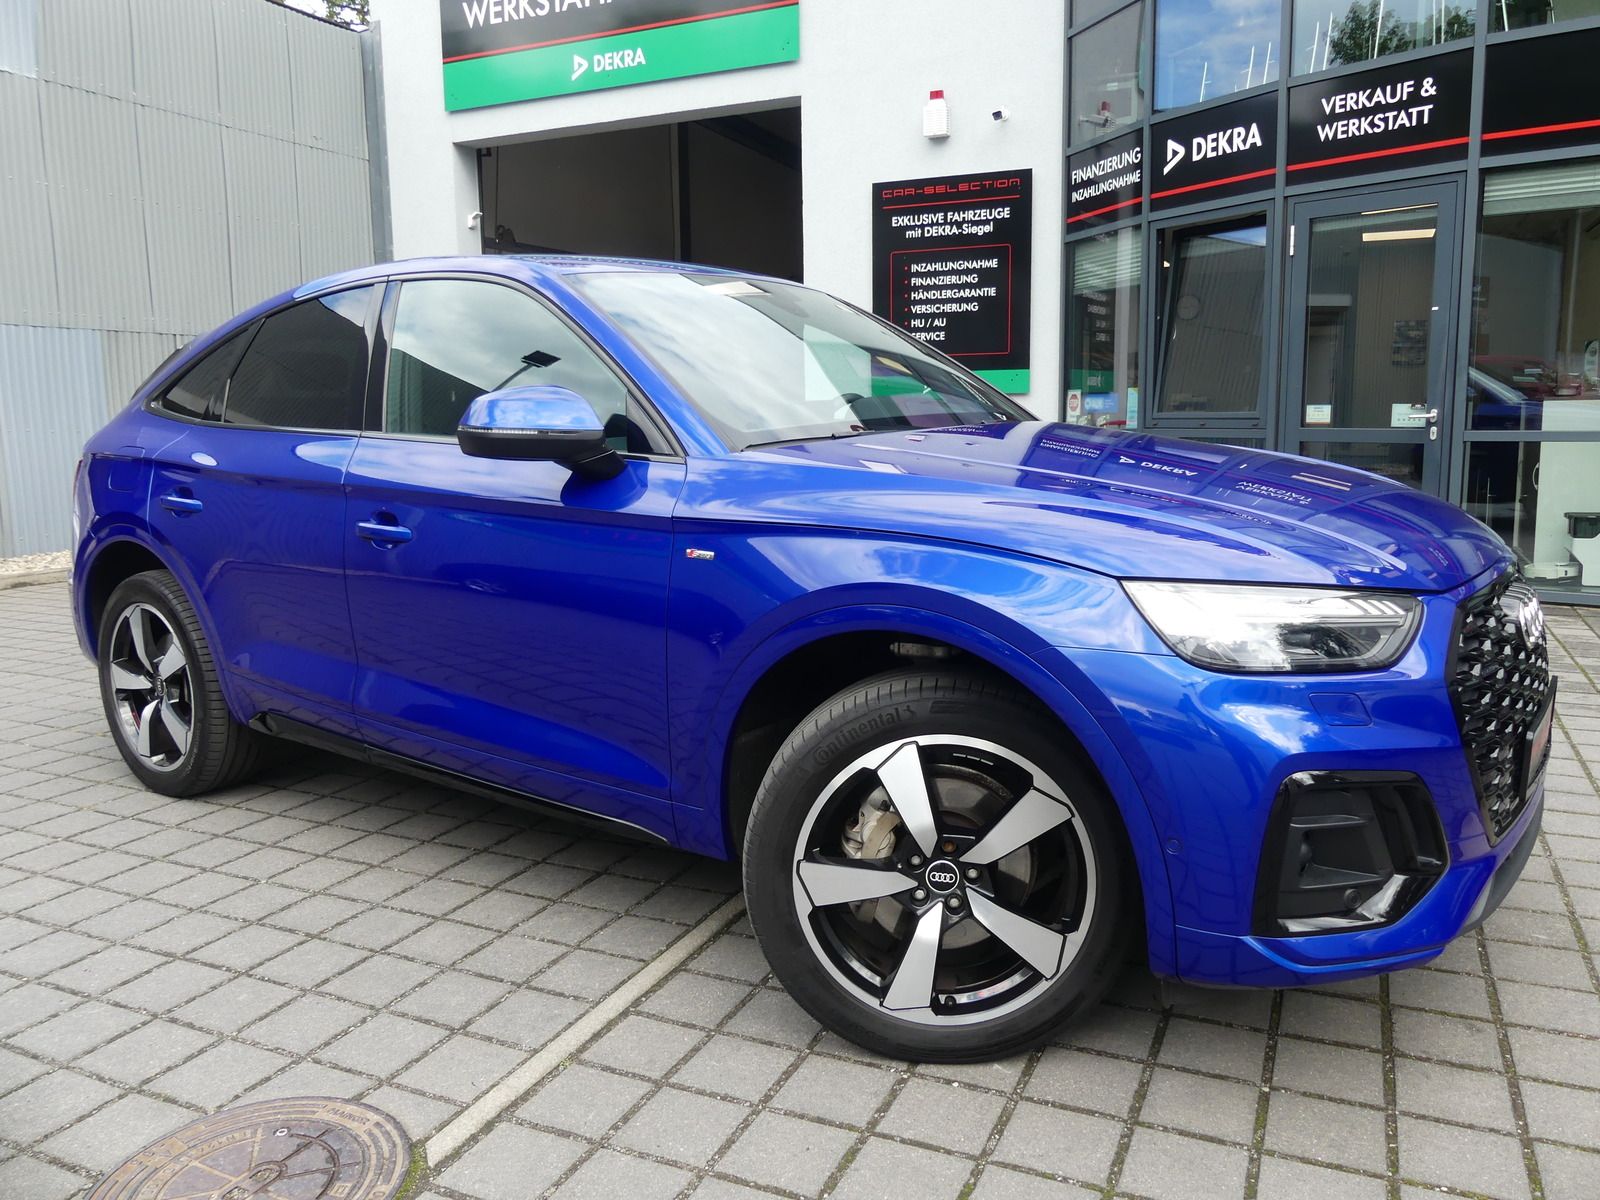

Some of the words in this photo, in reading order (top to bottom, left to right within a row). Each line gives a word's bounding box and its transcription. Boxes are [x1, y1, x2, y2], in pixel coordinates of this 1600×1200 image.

[462, 0, 606, 29] WERKS
[593, 47, 646, 72] DEKRA
[1321, 80, 1415, 116] VERKAUF
[1420, 77, 1437, 97] &
[1316, 104, 1434, 143] WERKSTATT
[1192, 122, 1262, 162] DEKRA
[1071, 147, 1141, 185] FINANZIERUNG
[1071, 170, 1141, 203] INZAHLUNGNAHME
[891, 212, 945, 227] EXKLUSIVE
[947, 207, 1011, 223] FAHRZEUGE
[905, 227, 922, 239] mit
[924, 221, 994, 237] DEKRA-Siegel
[911, 259, 998, 273] INZAHLUNGNAHME
[911, 274, 978, 287] FINANZIERUNG
[911, 287, 996, 300] HÄNDLERGARANTIE
[911, 302, 979, 314] VERSICHERUNG
[911, 319, 924, 328] HU
[933, 318, 946, 327] AU
[814, 707, 900, 765] Continental
